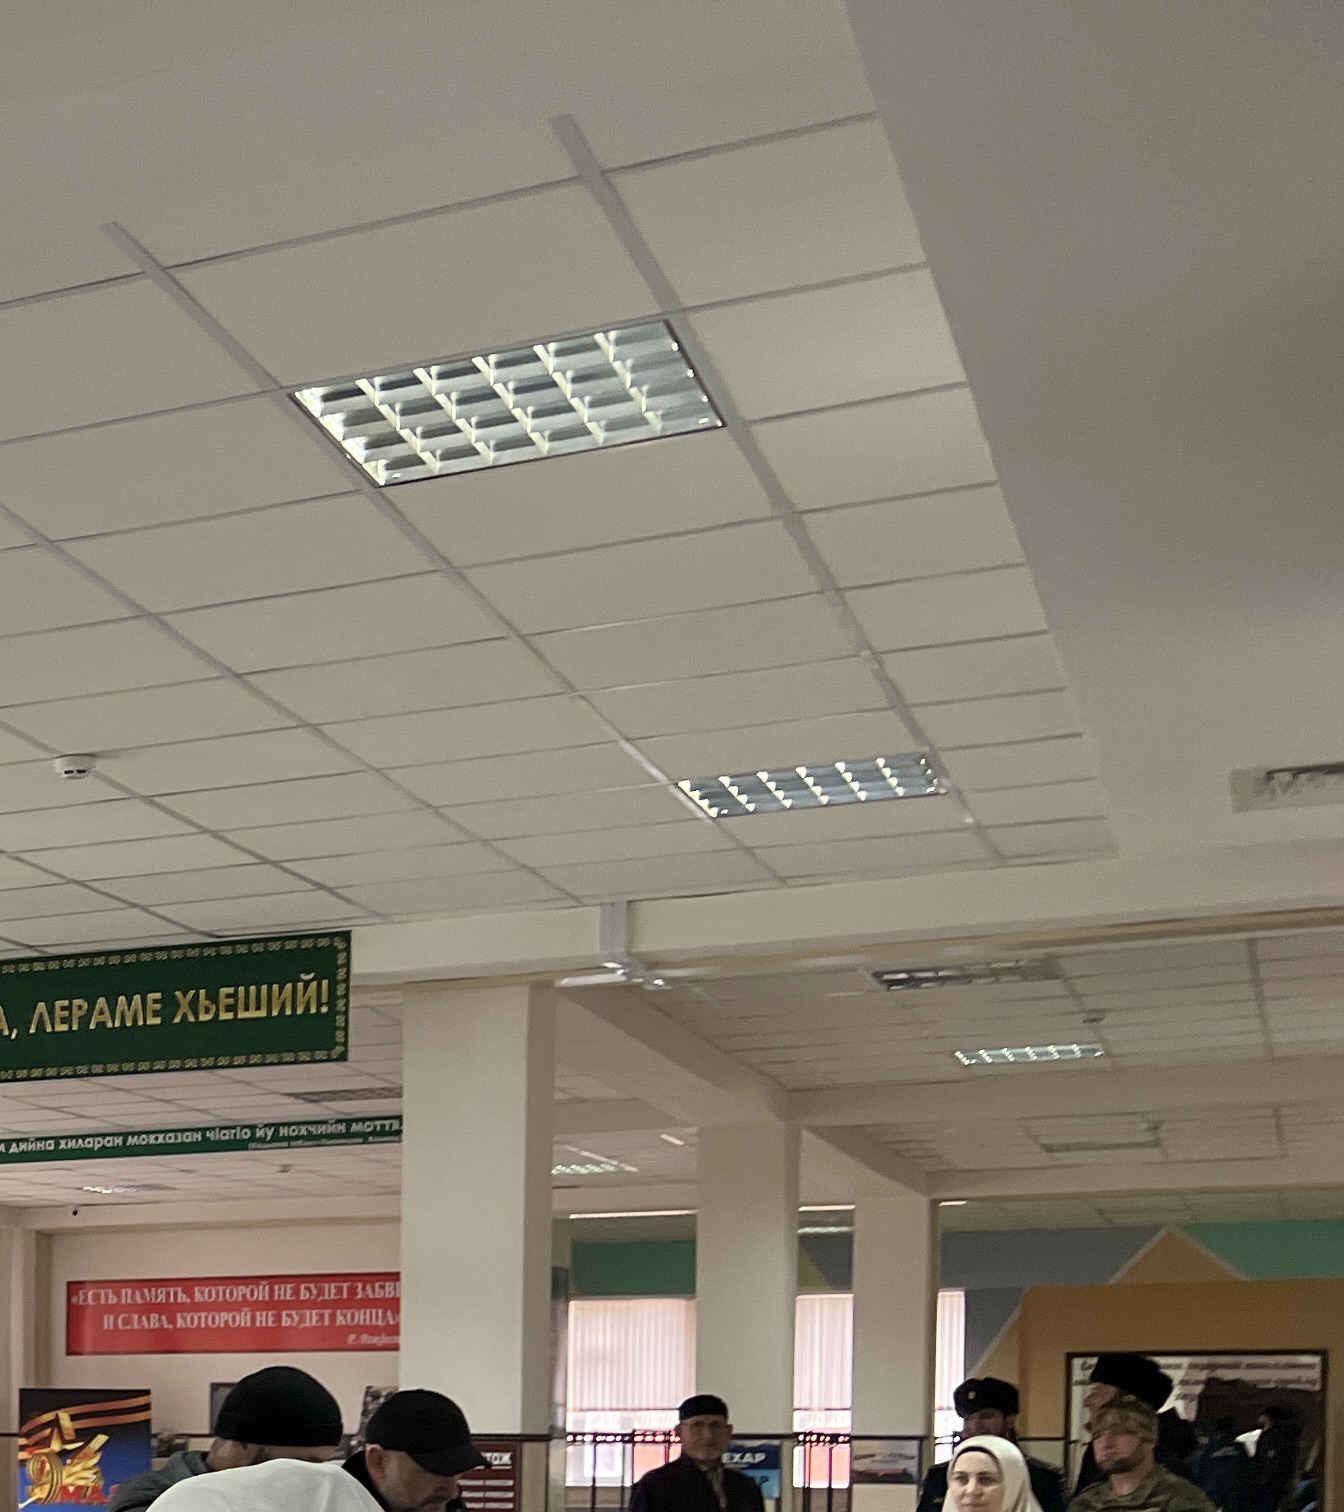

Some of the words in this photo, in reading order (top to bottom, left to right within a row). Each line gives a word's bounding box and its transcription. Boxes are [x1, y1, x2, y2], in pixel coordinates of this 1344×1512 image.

[29, 990, 163, 1034] ЛЕРАМЕ
[172, 972, 330, 1024] ХЬЕШИЙ!
[9, 1138, 55, 1154] дийна
[58, 1133, 124, 1151] хиларан
[279, 1120, 346, 1137] нохчийн
[194, 1281, 269, 1303] КОТОРОЙ
[274, 1284, 296, 1300] НЕ
[299, 1281, 351, 1302] БУДЕТ
[103, 1314, 115, 1331] И
[176, 1307, 251, 1329] КОТОРОЙ
[255, 1310, 278, 1327] НЕ
[281, 1308, 332, 1329] БУДЕТ
